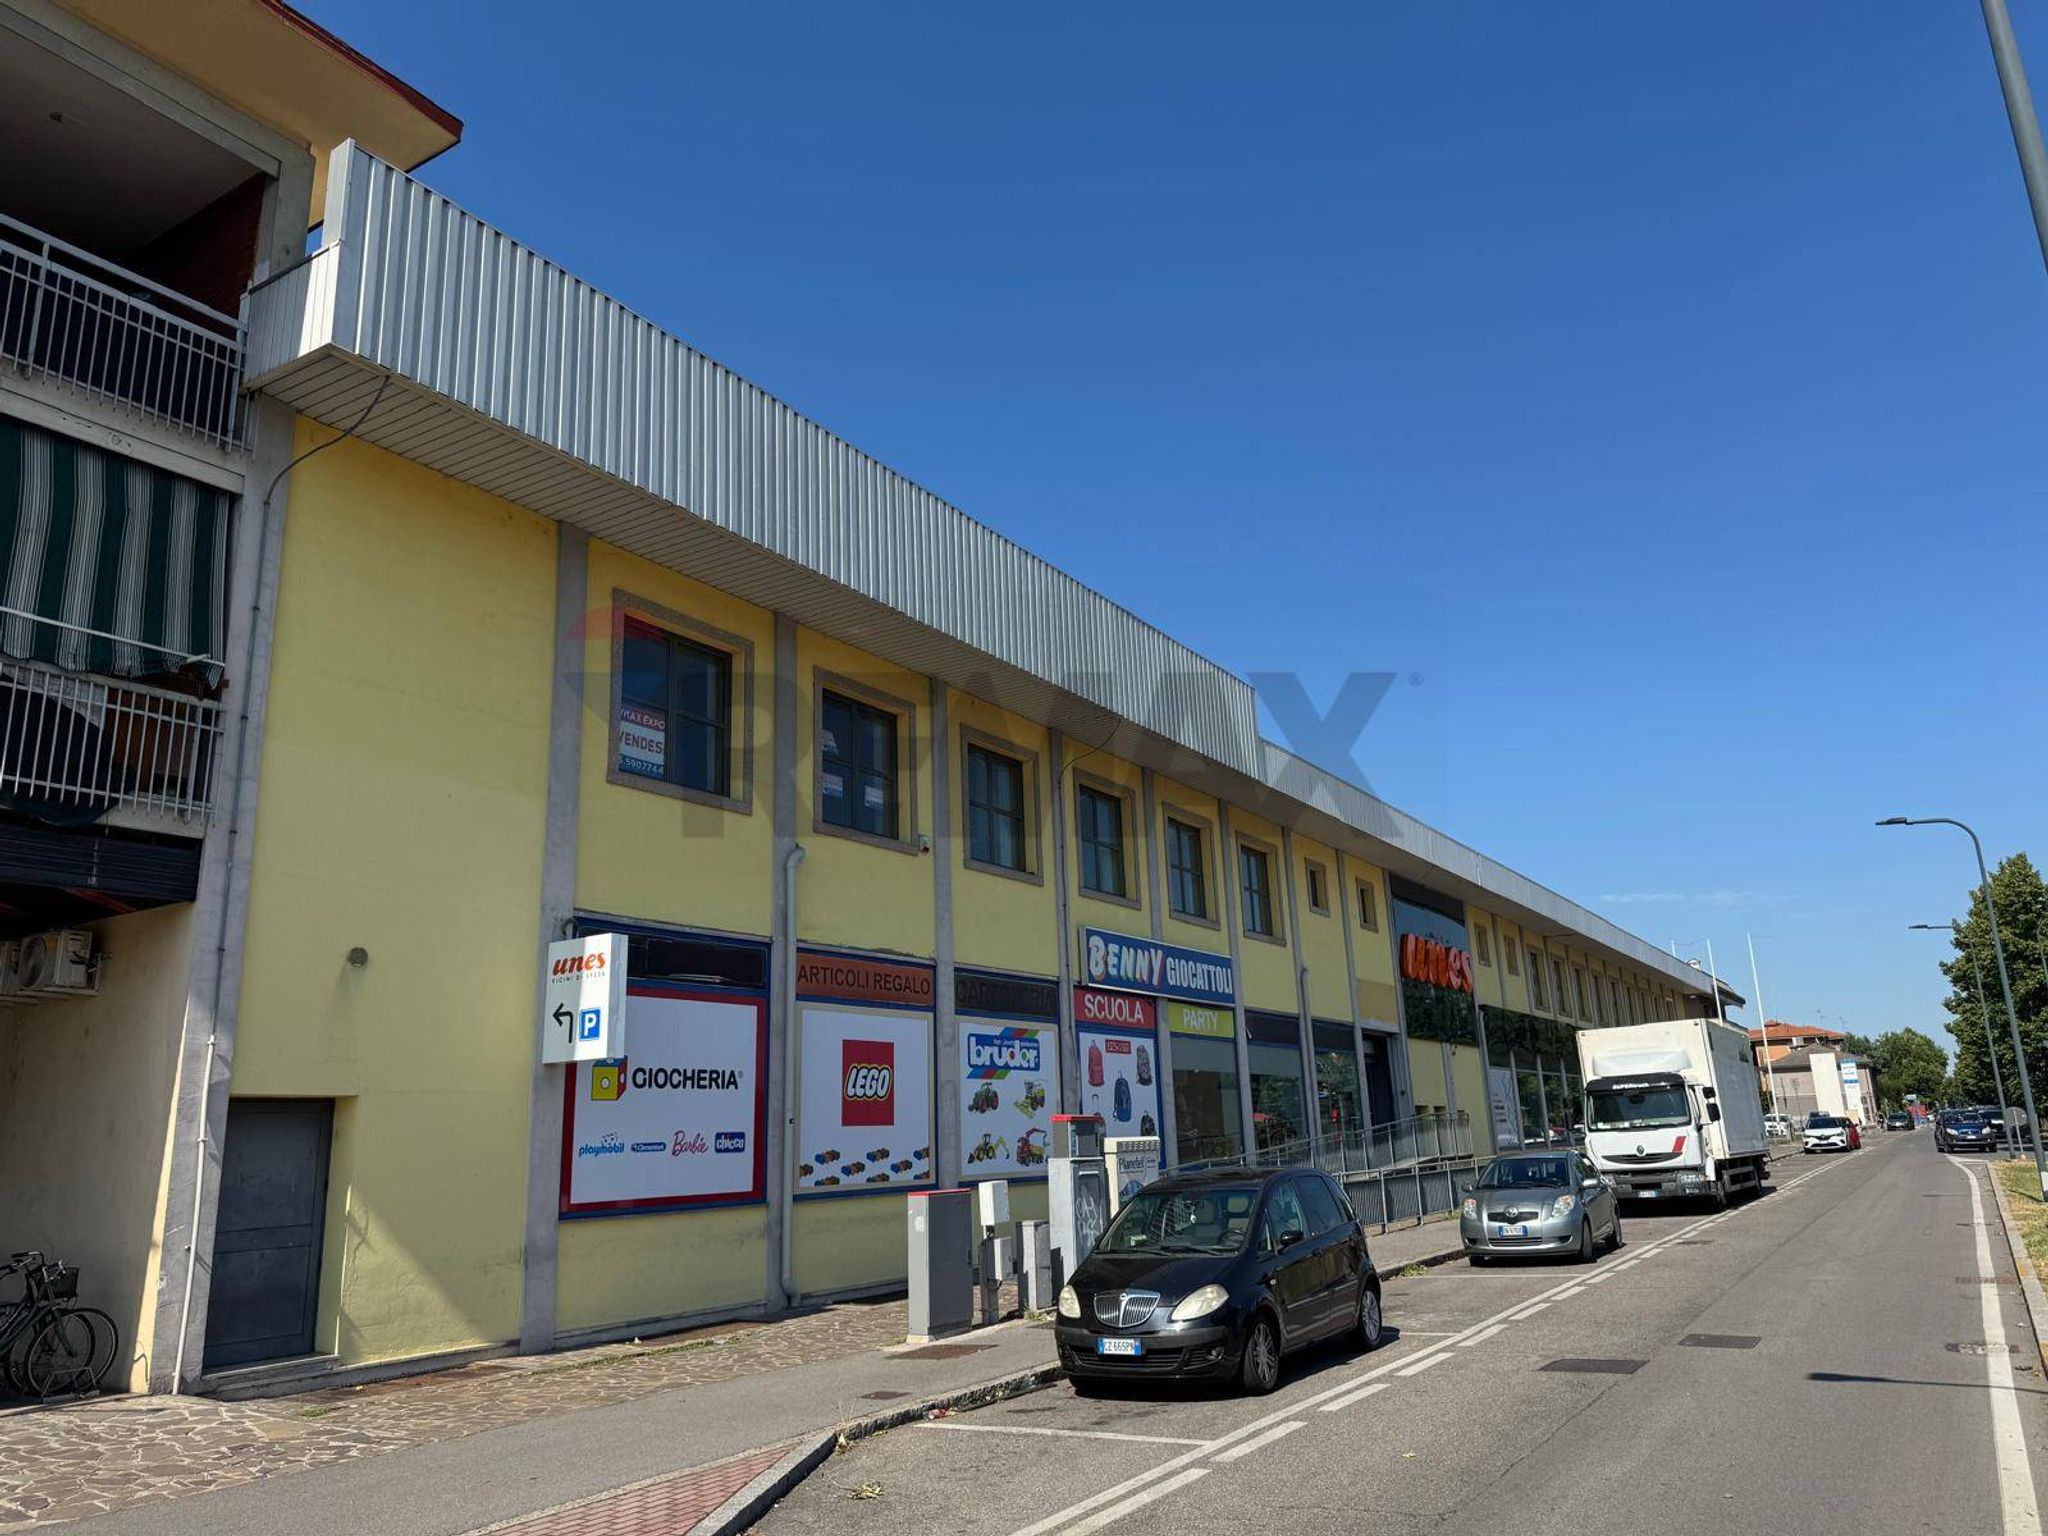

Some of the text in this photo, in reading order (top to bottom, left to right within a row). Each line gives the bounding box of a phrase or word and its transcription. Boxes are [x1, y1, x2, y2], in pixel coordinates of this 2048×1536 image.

[553, 953, 606, 976] unes
[1088, 935, 1233, 995] BENNY GIOCATTOLI
[1401, 932, 1474, 993] unes
[797, 964, 931, 995] ARTICOLI REGALO
[1084, 993, 1144, 1024] SCUOLA
[1182, 1008, 1219, 1032] PARTY
[583, 1013, 597, 1037] P
[969, 1036, 1038, 1068] bruder
[632, 1067, 739, 1090] GIOCHERIA
[846, 1067, 891, 1097] LEGO
[578, 1141, 625, 1157] playmobil
[671, 1130, 710, 1157] Barbie
